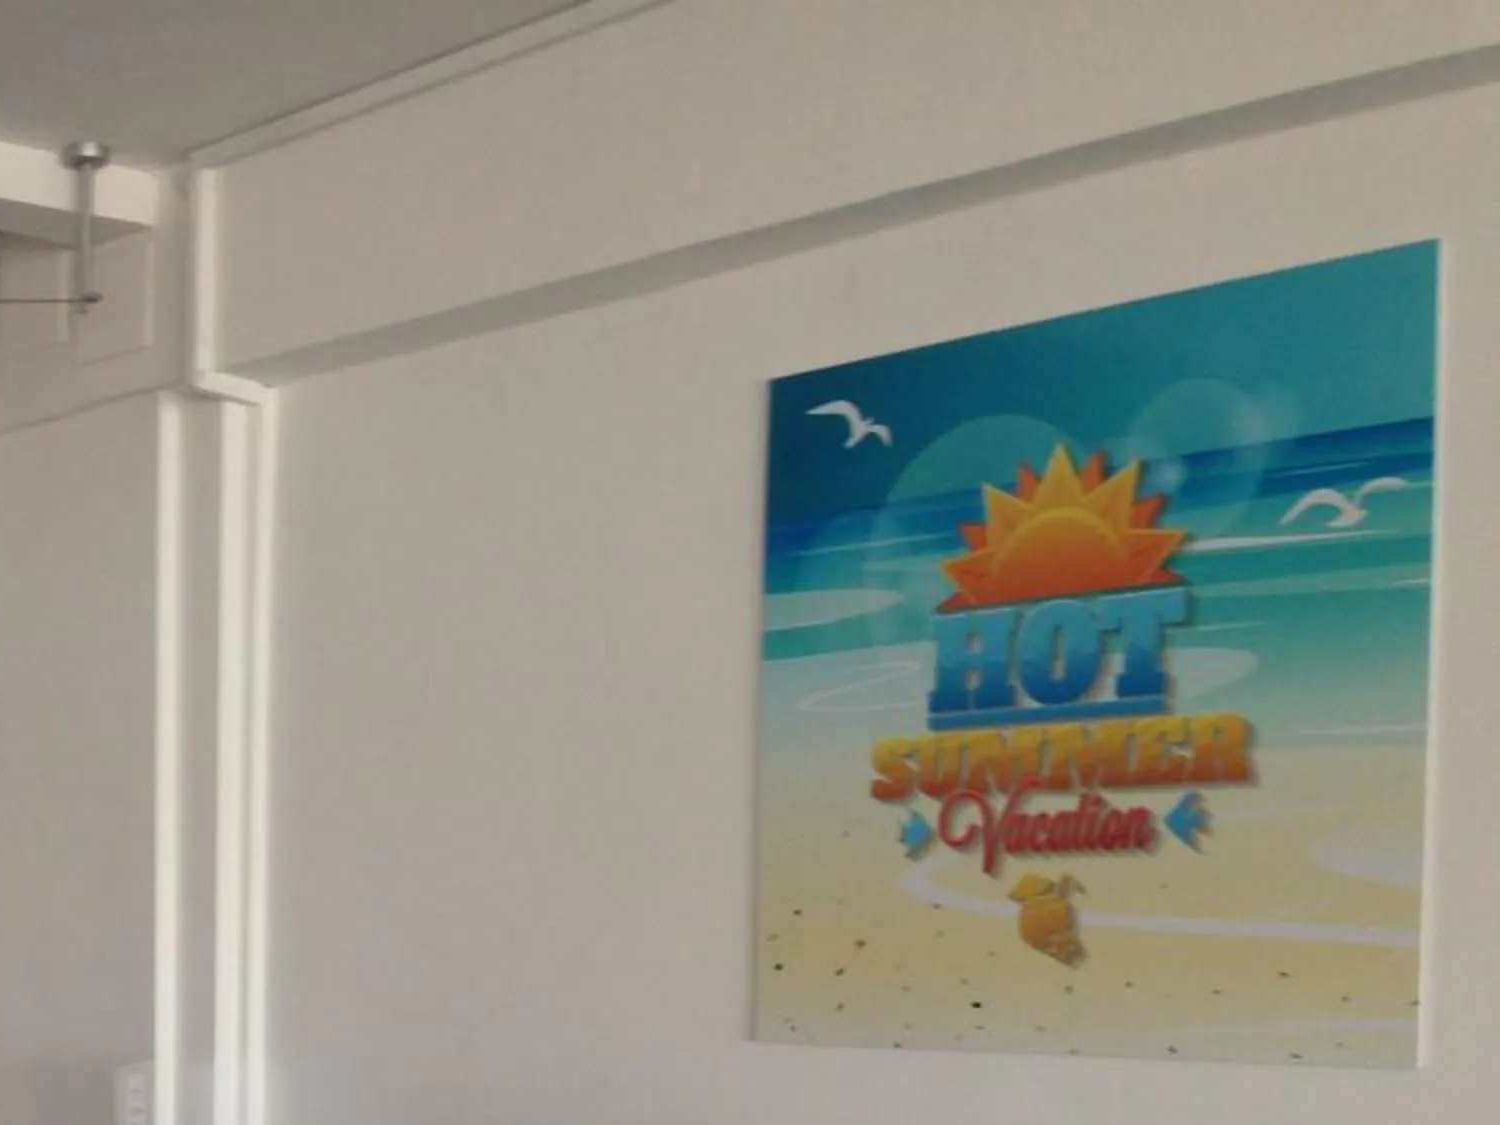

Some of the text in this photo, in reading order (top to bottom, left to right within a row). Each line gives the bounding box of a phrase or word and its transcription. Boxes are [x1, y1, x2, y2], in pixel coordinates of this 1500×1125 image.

[928, 586, 1188, 715] HOT
[871, 713, 1253, 800] SUMMER
[938, 777, 1157, 874] Vacation
